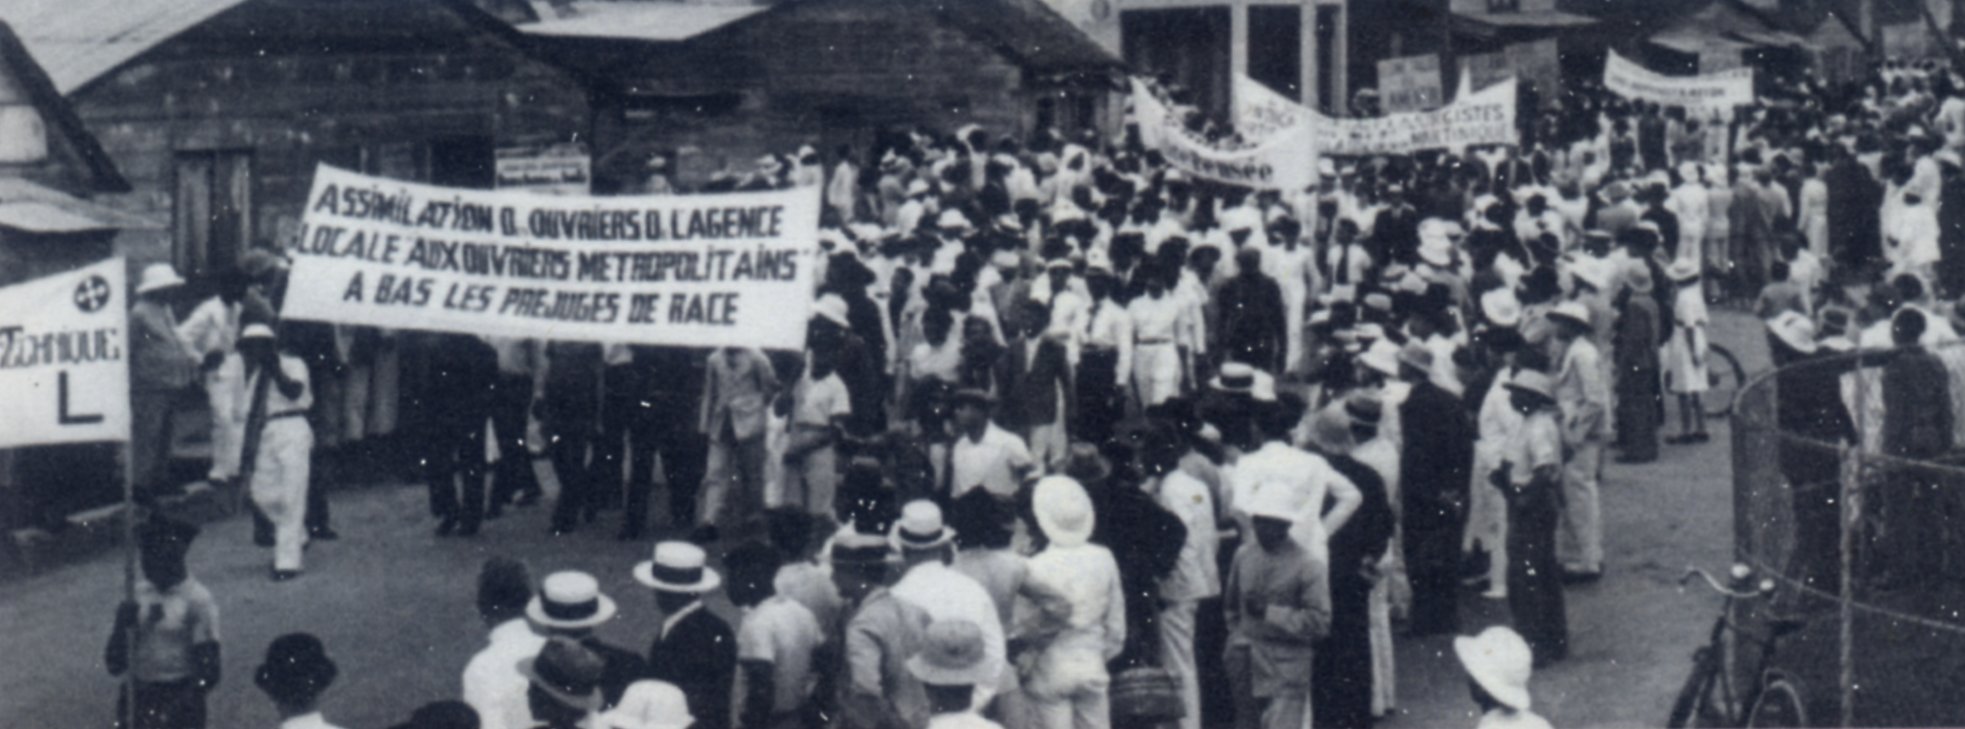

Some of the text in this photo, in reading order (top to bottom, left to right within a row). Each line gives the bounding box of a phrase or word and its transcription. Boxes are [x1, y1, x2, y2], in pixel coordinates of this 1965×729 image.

[528, 203, 641, 240] OUVRIERS
[297, 222, 402, 263] LOCALE
[462, 242, 571, 281] OUVRIERS
[342, 271, 740, 326] A BAS LES PREJUGES DE RACE
